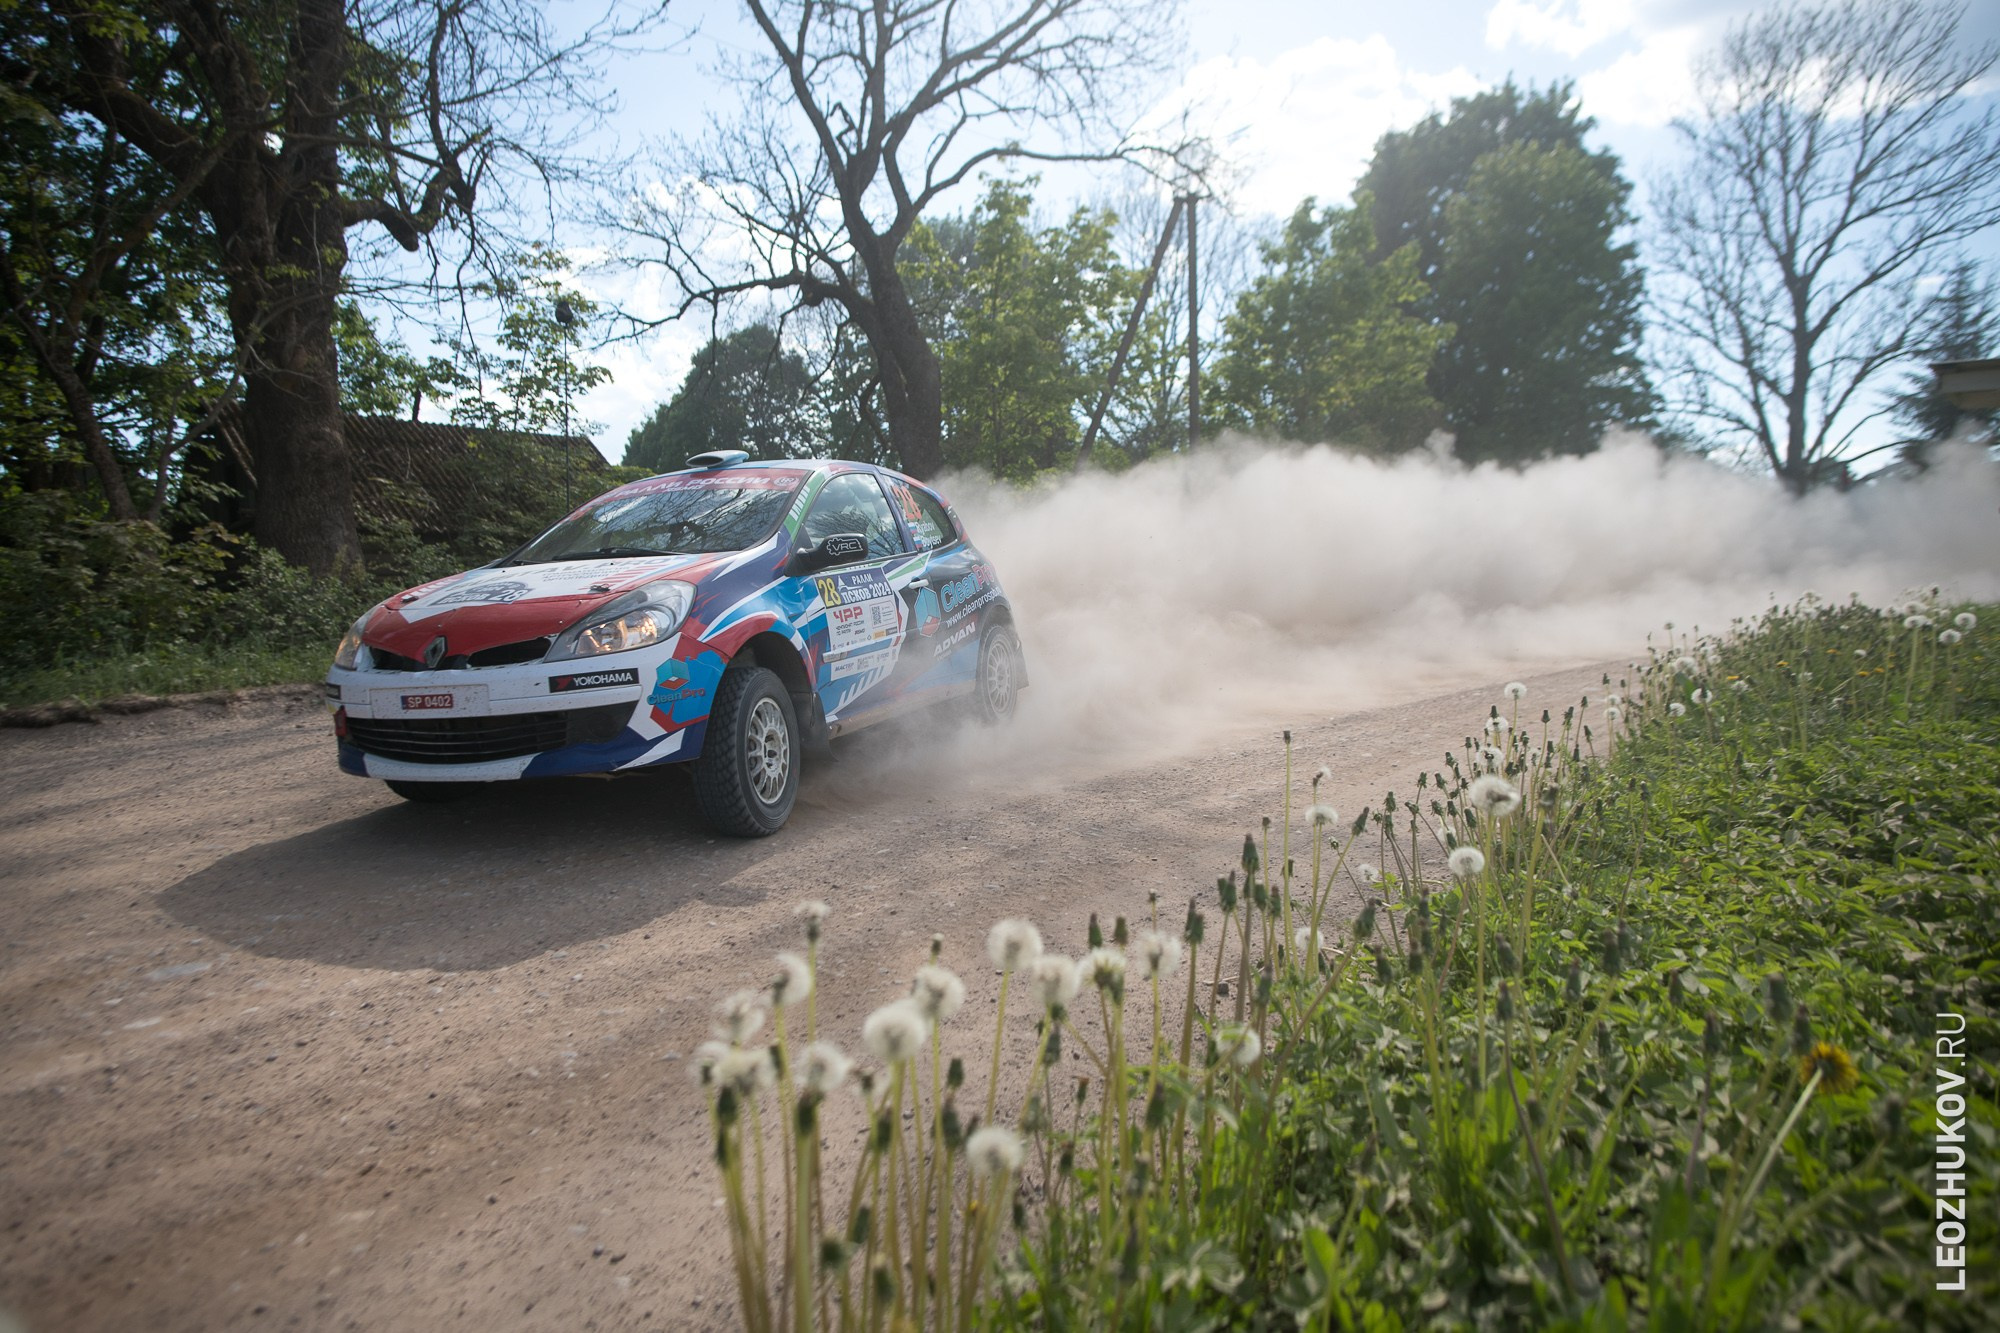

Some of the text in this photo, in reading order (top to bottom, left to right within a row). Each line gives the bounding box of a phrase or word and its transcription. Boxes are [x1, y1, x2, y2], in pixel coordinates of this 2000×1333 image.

[691, 477, 770, 486] РОССИИ
[891, 485, 922, 520] 28
[832, 541, 857, 551] VRC
[851, 573, 873, 585] РАЛЛИ
[488, 589, 528, 602] 28
[818, 577, 842, 607] 28
[841, 582, 892, 604] ПСКОВ 2024
[833, 606, 863, 622] ЧРР
[933, 621, 976, 657] ADVAN
[573, 672, 633, 687] YOKOHAMA
[408, 695, 451, 708] SP 0402
[646, 687, 706, 706] CleanPro
